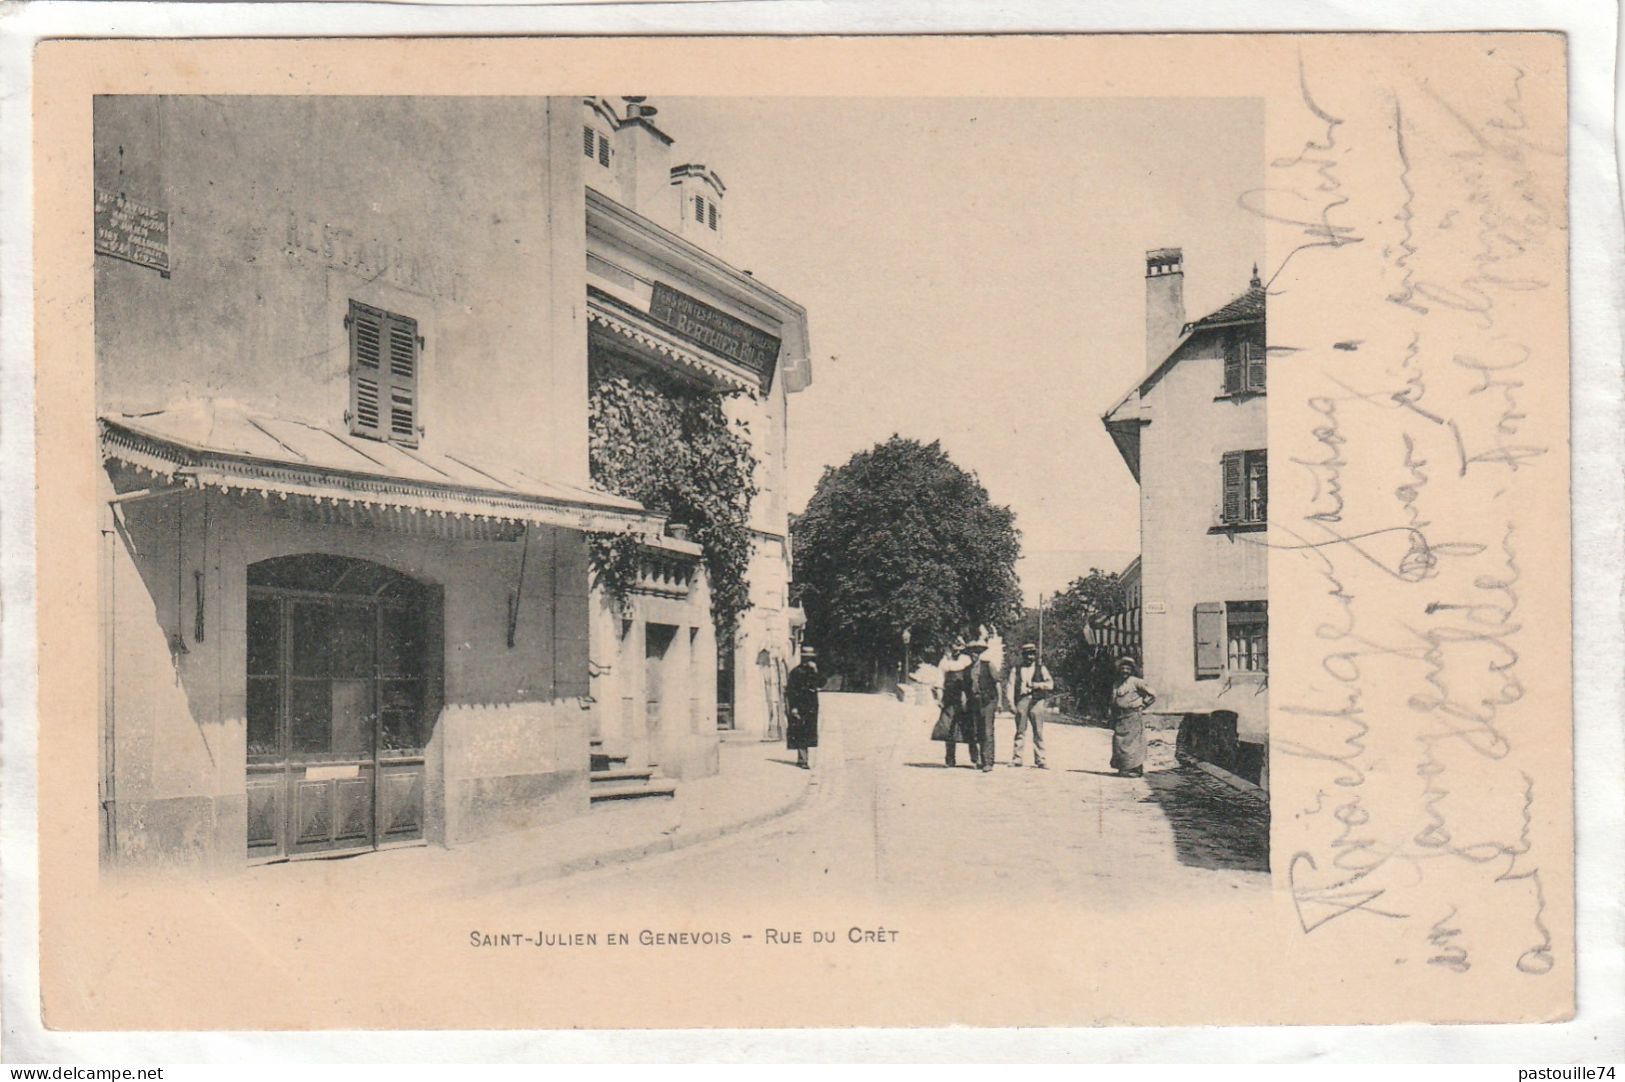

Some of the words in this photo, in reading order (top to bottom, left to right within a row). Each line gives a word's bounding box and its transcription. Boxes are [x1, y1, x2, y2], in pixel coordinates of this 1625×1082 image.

[470, 930, 598, 948] SAINT-JULIEN
[606, 932, 630, 946] EN
[638, 929, 732, 946] GENEVOIS
[764, 928, 803, 945] RUE
[812, 931, 837, 944] DU
[847, 926, 900, 944] CRÊT
